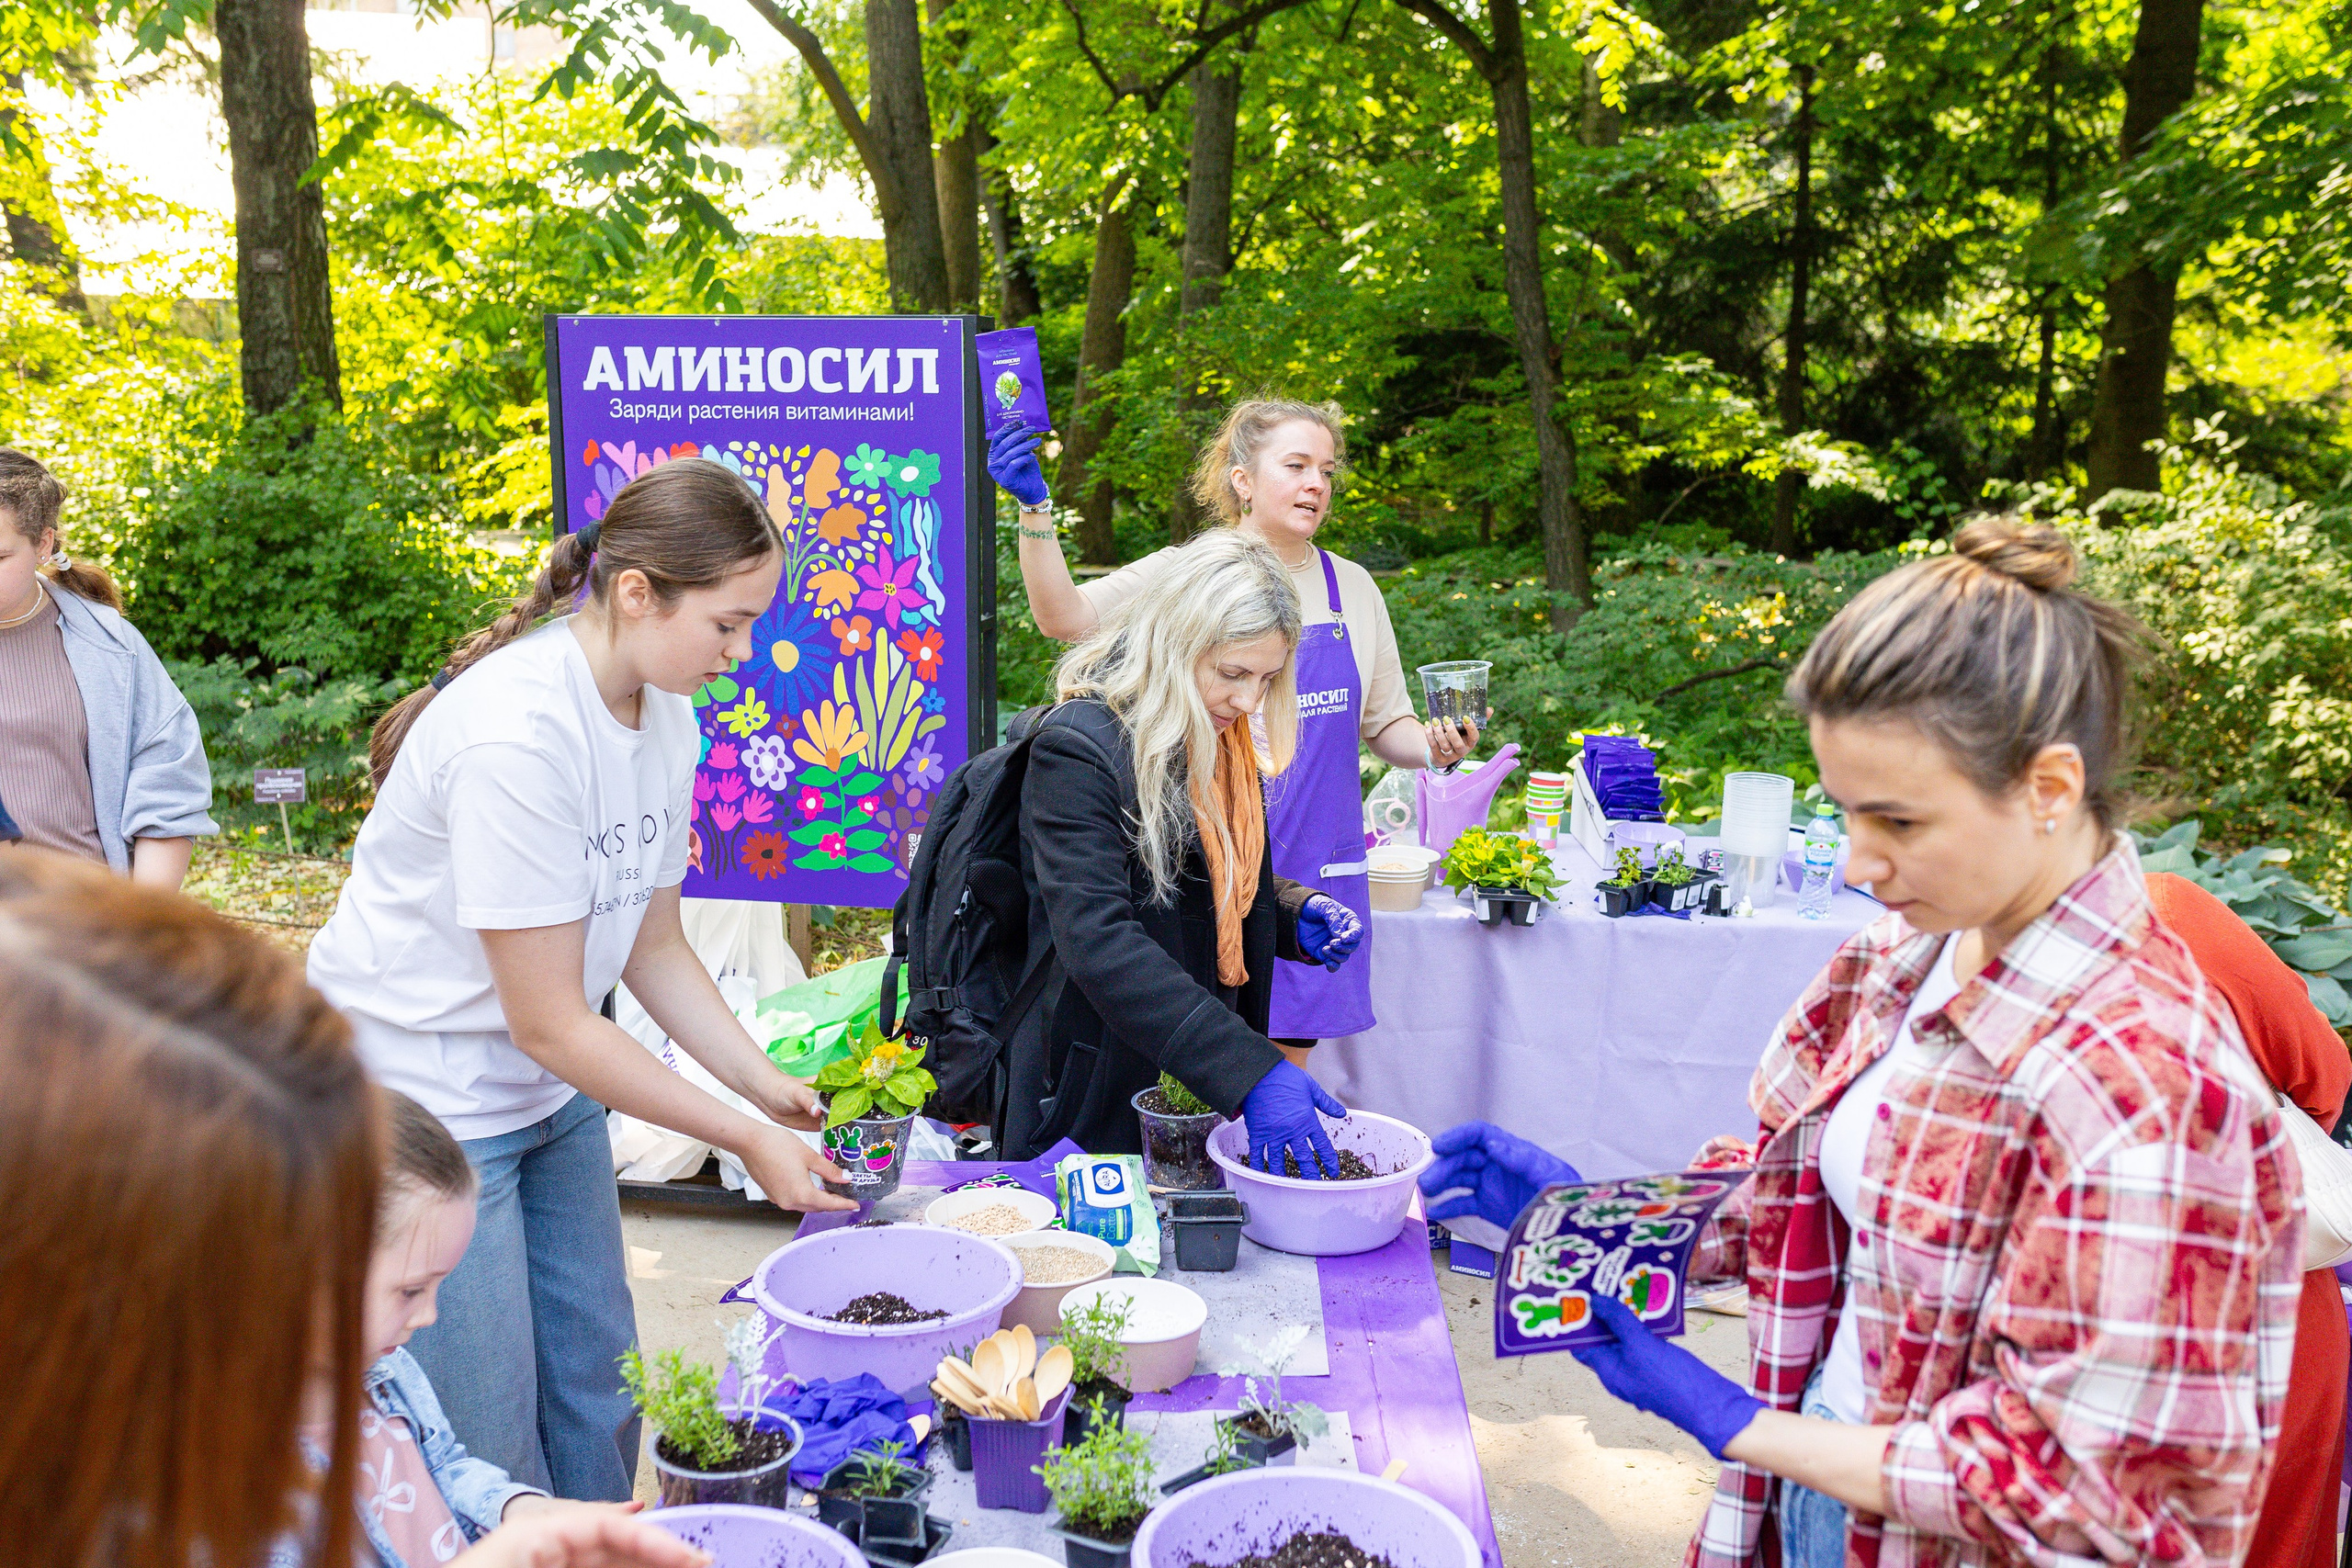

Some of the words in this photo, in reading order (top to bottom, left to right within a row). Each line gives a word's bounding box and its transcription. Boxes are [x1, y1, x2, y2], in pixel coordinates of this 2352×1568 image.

[583, 345, 940, 394] АМИНОСИЛ
[609, 398, 682, 424] Заряди
[688, 402, 779, 424] растения
[786, 401, 915, 422] витаминами!
[1296, 688, 1349, 707] НОСИЛ
[1301, 708, 1316, 718] ДЛЯ
[1317, 703, 1347, 715] РАСТЕНИЙ
[1102, 1169, 1111, 1188] AURA
[1097, 1218, 1106, 1240] Pure
[1106, 1209, 1115, 1240] Cotton
[1451, 1265, 1490, 1277] АМИНОСИЛ
